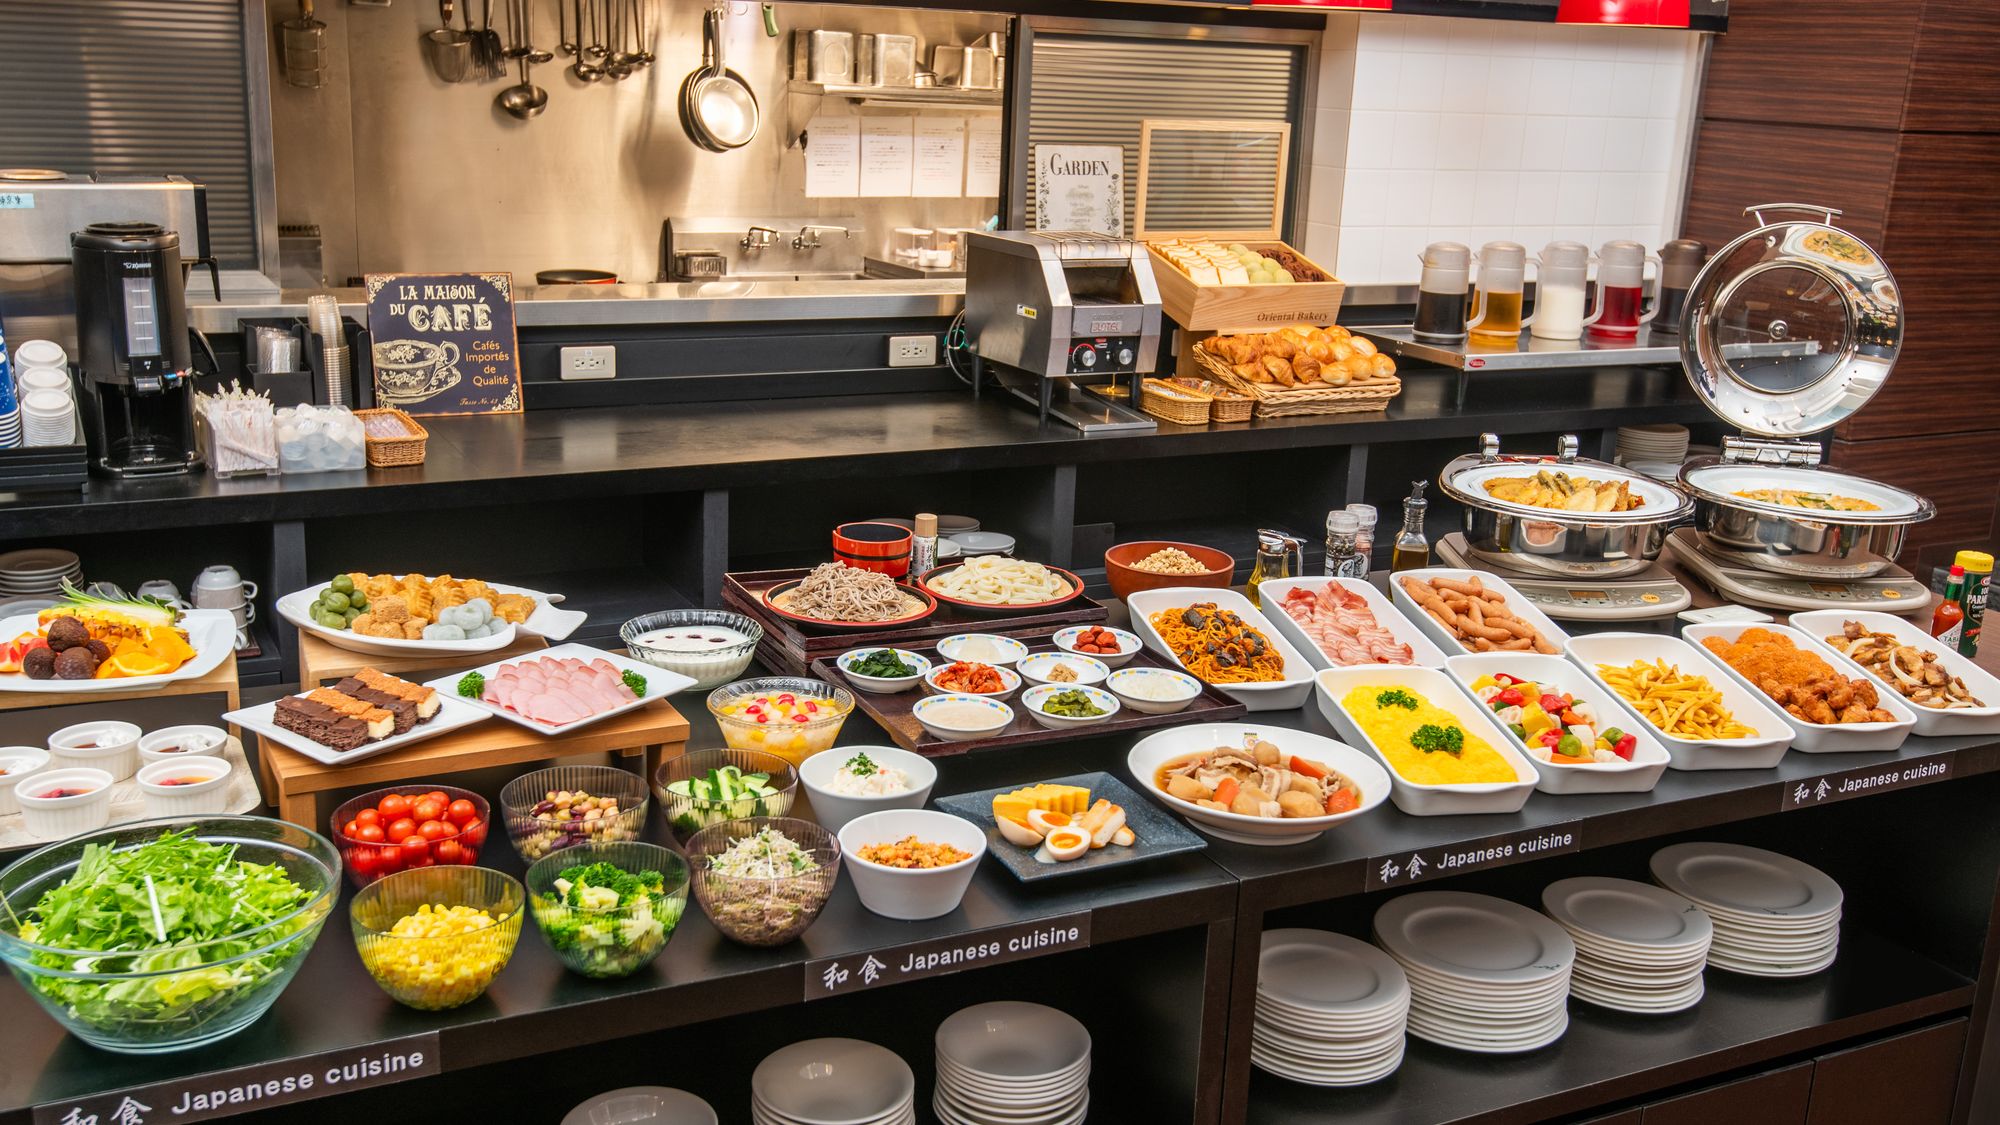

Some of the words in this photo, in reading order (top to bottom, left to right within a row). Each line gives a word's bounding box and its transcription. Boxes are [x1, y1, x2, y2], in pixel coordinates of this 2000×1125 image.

[1050, 153, 1109, 176] GARDEN
[399, 285, 419, 300] LA
[424, 285, 477, 300] MAISON
[390, 304, 406, 315] DU
[408, 297, 493, 332] CAFÉ
[1257, 312, 1295, 321] Oriental
[1297, 312, 1328, 322] Bakery
[473, 340, 500, 351] Cafés
[466, 351, 510, 363] Importés
[484, 365, 497, 374] de
[473, 375, 509, 387] Qualité
[1793, 778, 1832, 804] 和食
[1838, 772, 1899, 793] Japanese
[1903, 762, 1946, 781] cuisine
[1379, 853, 1428, 883] 和食
[1437, 845, 1513, 869] Japanese
[1518, 833, 1572, 854] cuisine
[823, 954, 887, 991] 和食
[900, 942, 1000, 972] Japanese
[1008, 927, 1079, 952] cuisine
[171, 1073, 314, 1115] Japanese
[325, 1052, 424, 1084] cuisine
